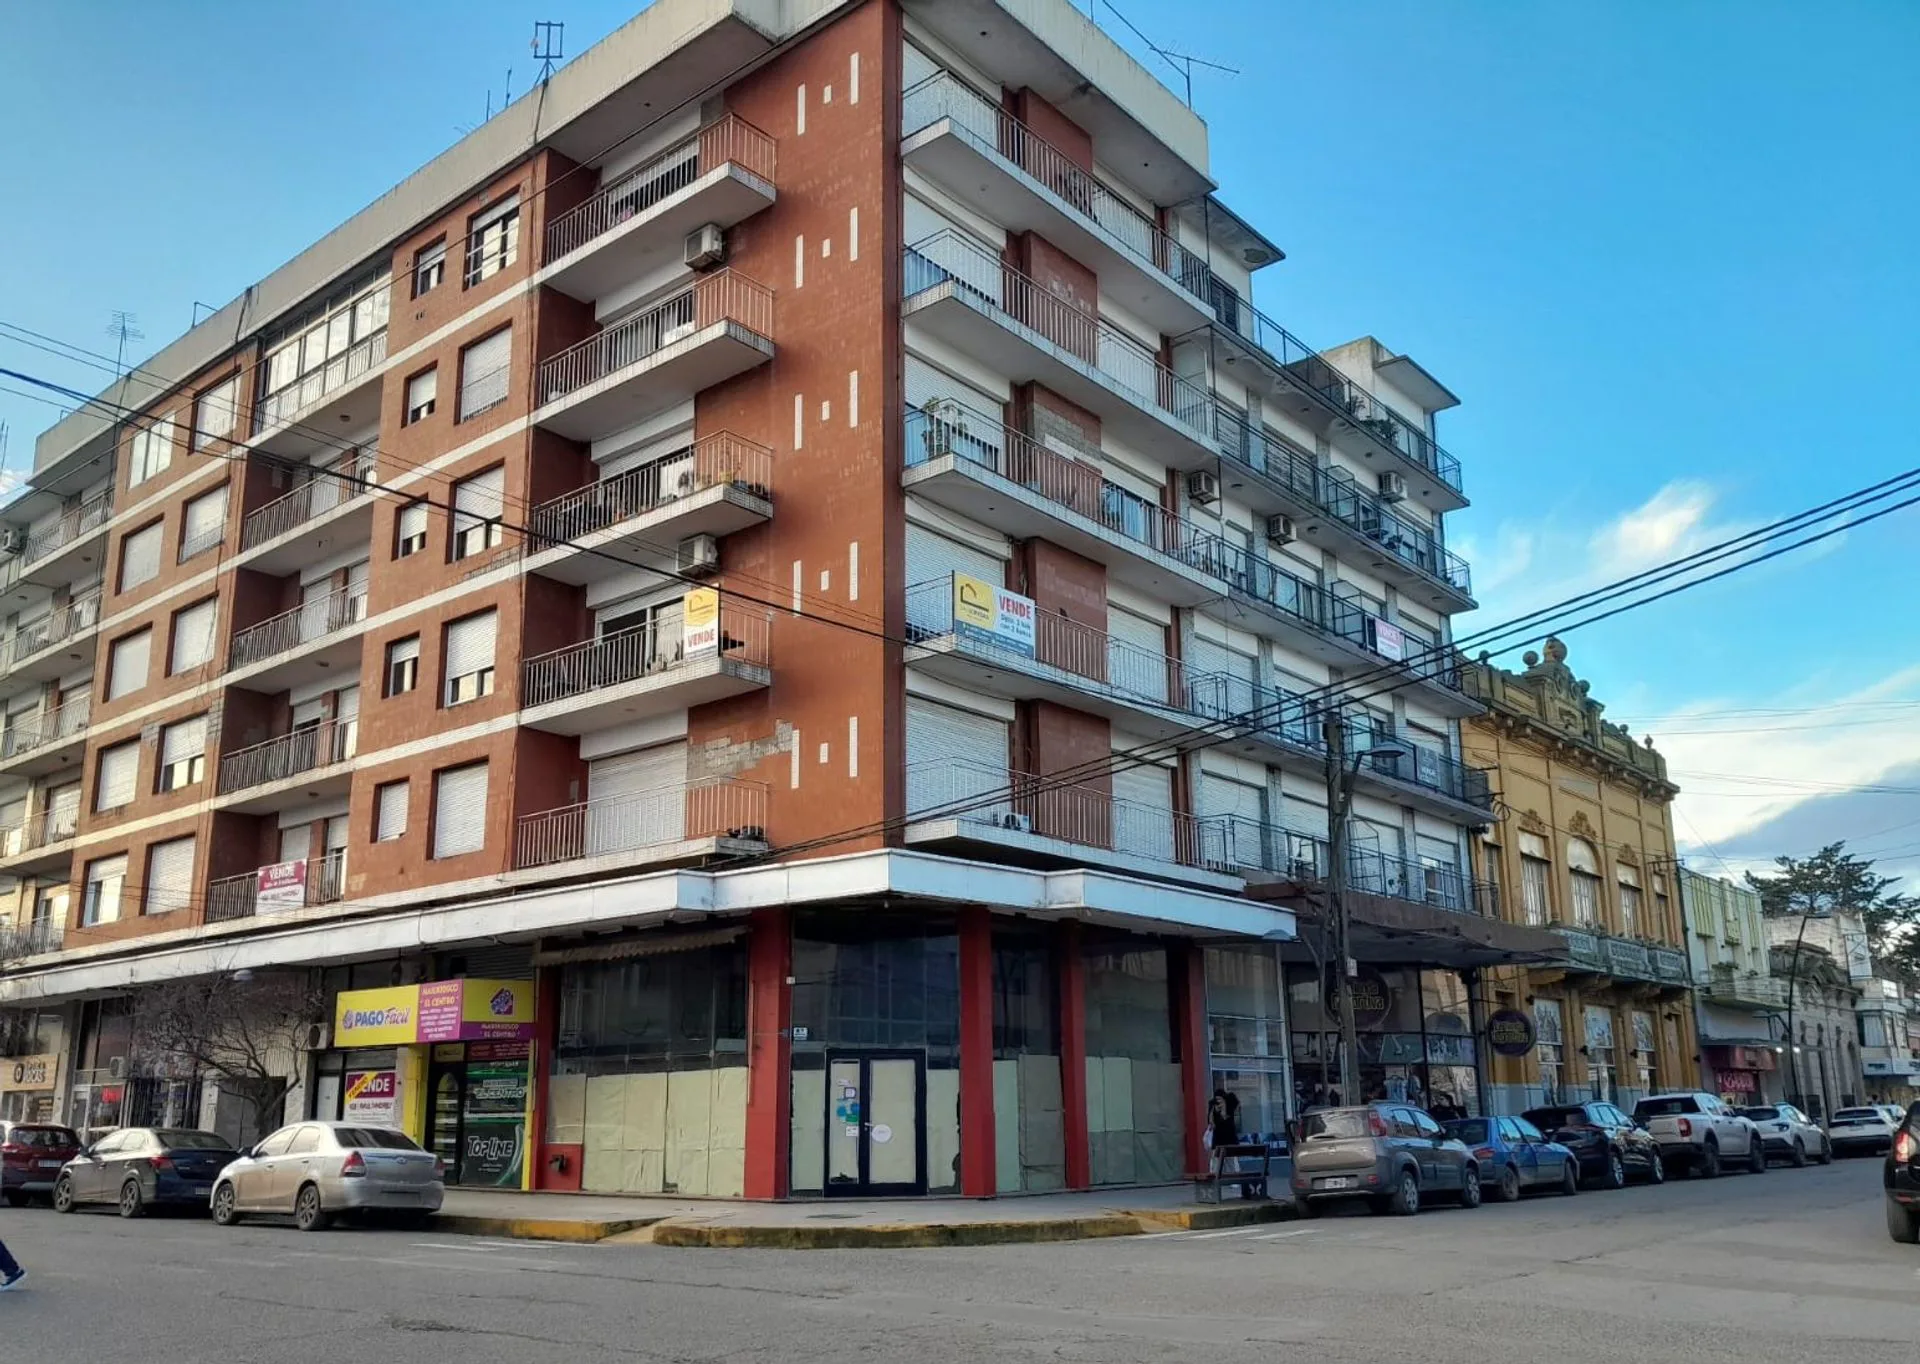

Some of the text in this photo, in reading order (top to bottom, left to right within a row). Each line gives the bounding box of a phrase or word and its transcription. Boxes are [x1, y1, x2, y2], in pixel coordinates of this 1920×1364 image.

[999, 595, 1031, 619] VENDE
[688, 629, 715, 648] VENDE
[269, 864, 295, 880] VENDE
[355, 1010, 385, 1027] PAGO
